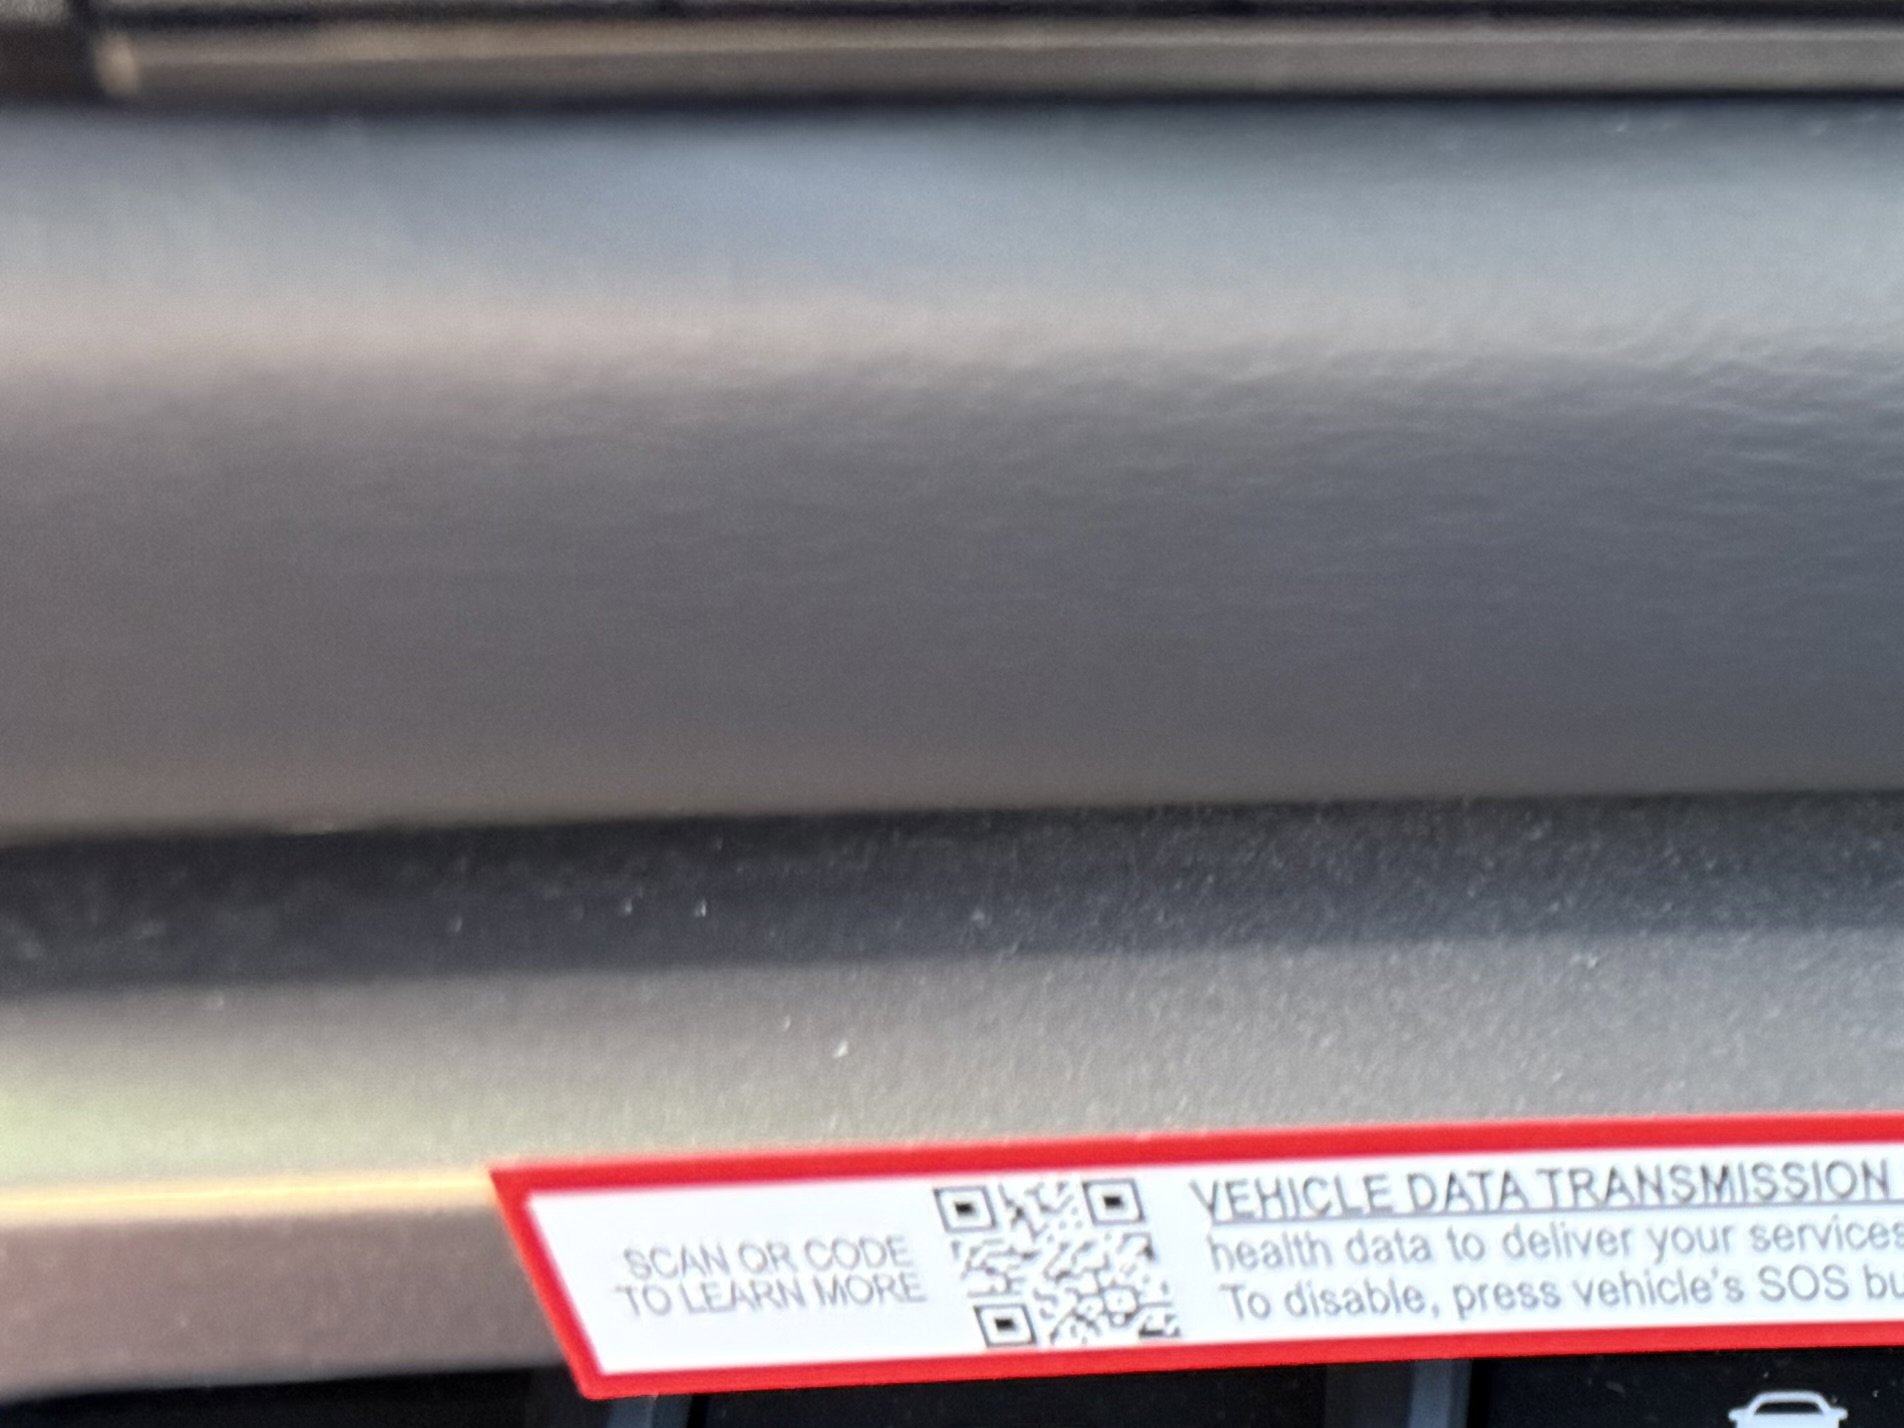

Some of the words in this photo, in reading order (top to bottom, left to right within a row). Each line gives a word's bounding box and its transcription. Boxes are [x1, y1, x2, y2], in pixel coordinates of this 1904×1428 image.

[1190, 1174, 1393, 1221] VEHICLE
[1406, 1168, 1530, 1213] DATA
[1536, 1156, 1890, 1207] TRANSMISSION
[623, 1243, 730, 1281] SCAN
[803, 1235, 914, 1272] CODE
[1206, 1230, 1333, 1273] health
[1345, 1227, 1432, 1269] data
[1446, 1230, 1486, 1264] to
[1502, 1221, 1632, 1261] deliver
[1647, 1226, 1732, 1264] your
[615, 1282, 672, 1317] TO
[679, 1278, 807, 1315] LEARN
[813, 1272, 928, 1307] MORE
[1219, 1283, 1271, 1322] To
[1284, 1277, 1440, 1319] disable,
[1453, 1281, 1561, 1320] press
[1572, 1267, 1744, 1308] vehicle's
[1757, 1264, 1850, 1302] SOS
